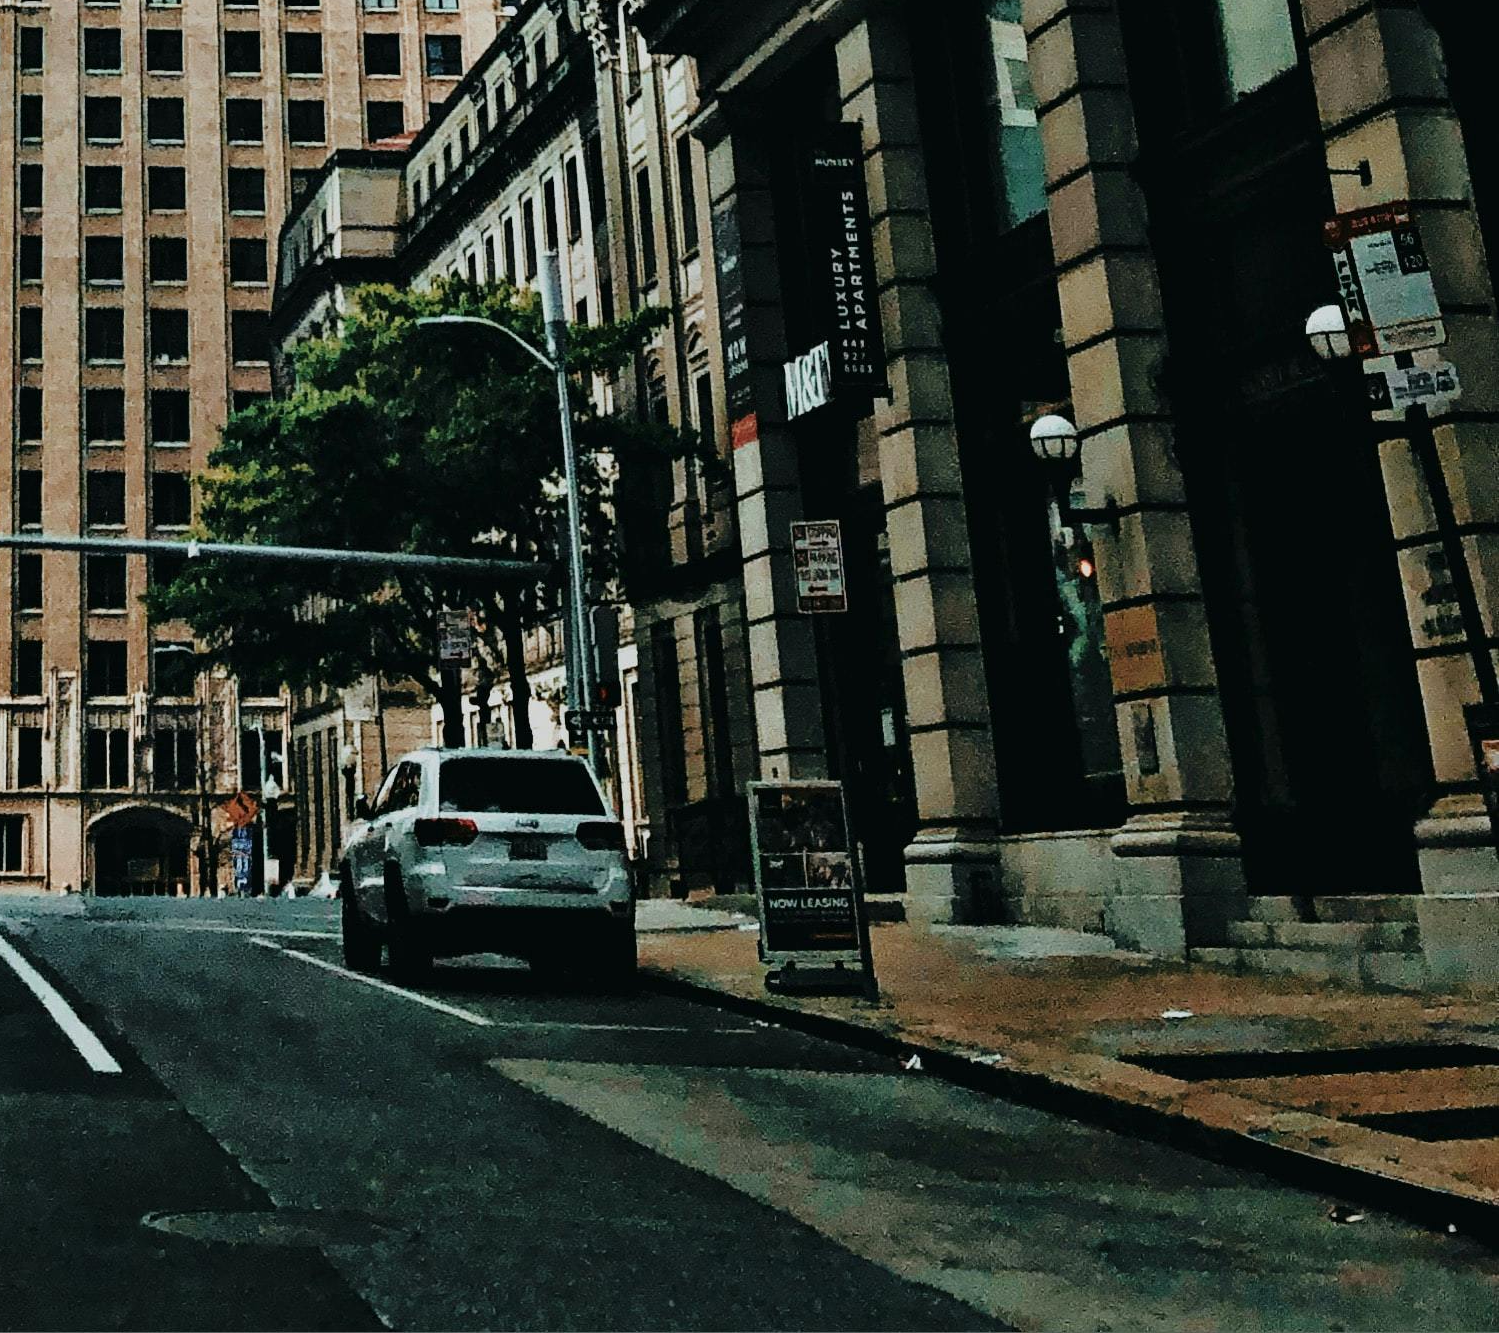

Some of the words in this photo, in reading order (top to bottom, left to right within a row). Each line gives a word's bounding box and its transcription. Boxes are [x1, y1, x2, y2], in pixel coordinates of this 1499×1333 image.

[831, 248, 852, 331] LUXURY
[841, 191, 868, 331] APARTMENTS
[783, 340, 832, 421] M&T
[769, 897, 797, 910] NOW
[801, 896, 850, 910] LEASING
